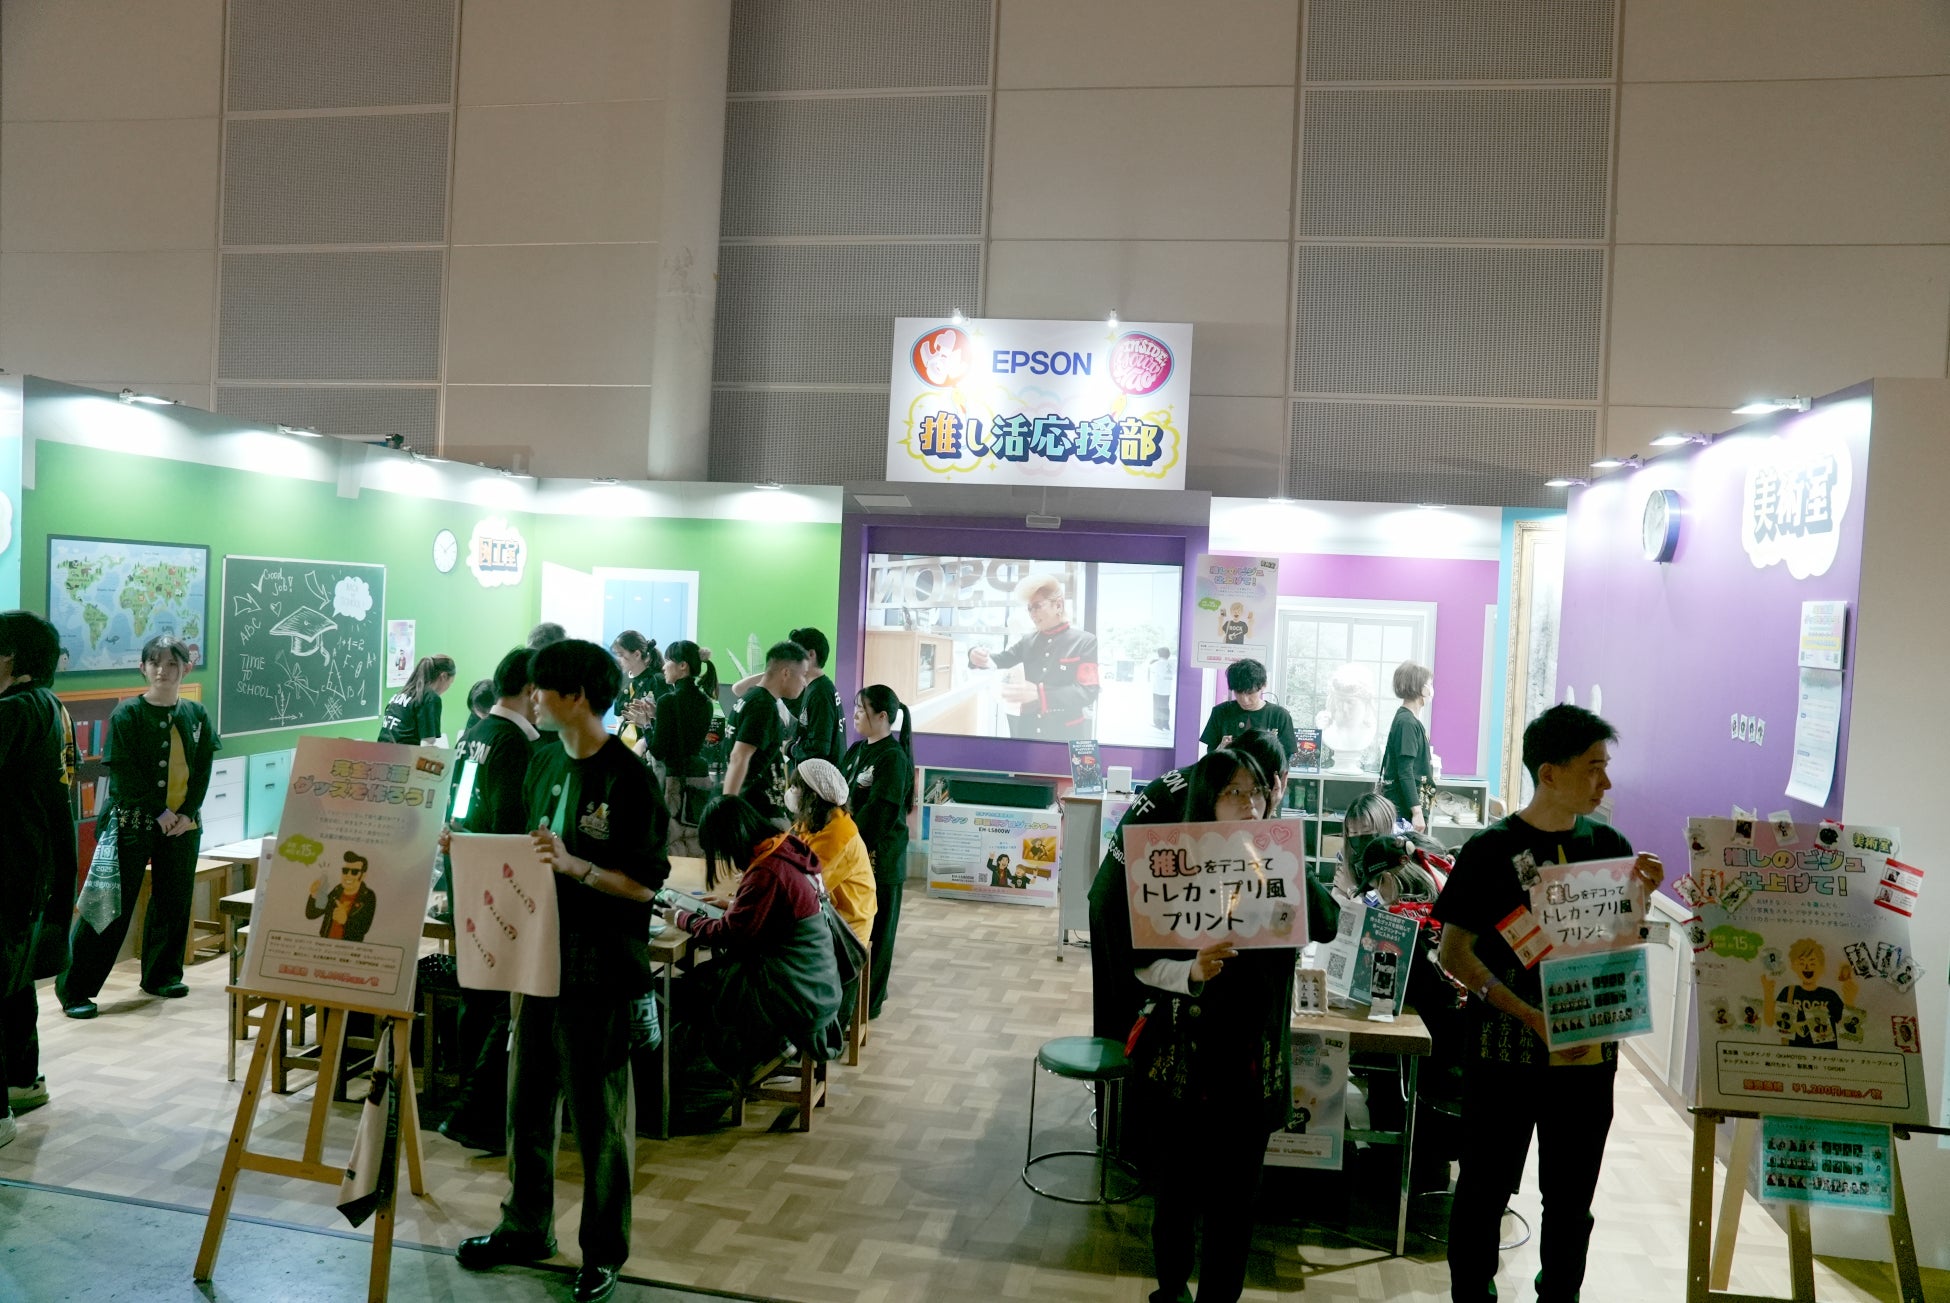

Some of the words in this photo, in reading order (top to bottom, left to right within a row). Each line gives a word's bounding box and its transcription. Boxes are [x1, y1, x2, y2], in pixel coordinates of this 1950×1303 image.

[992, 350, 1092, 376] EPSON
[918, 410, 1163, 467] 推し活応援部
[263, 568, 283, 581] Good
[239, 617, 263, 646] ABC
[239, 653, 266, 671] TIME
[241, 669, 253, 681] TO
[236, 681, 274, 699] SCHOOL
[1149, 848, 1274, 878] 推しをデコって
[1142, 878, 1287, 903] トレカ・プリ風
[1162, 911, 1244, 932] プリント
[1733, 936, 1749, 951] 15
